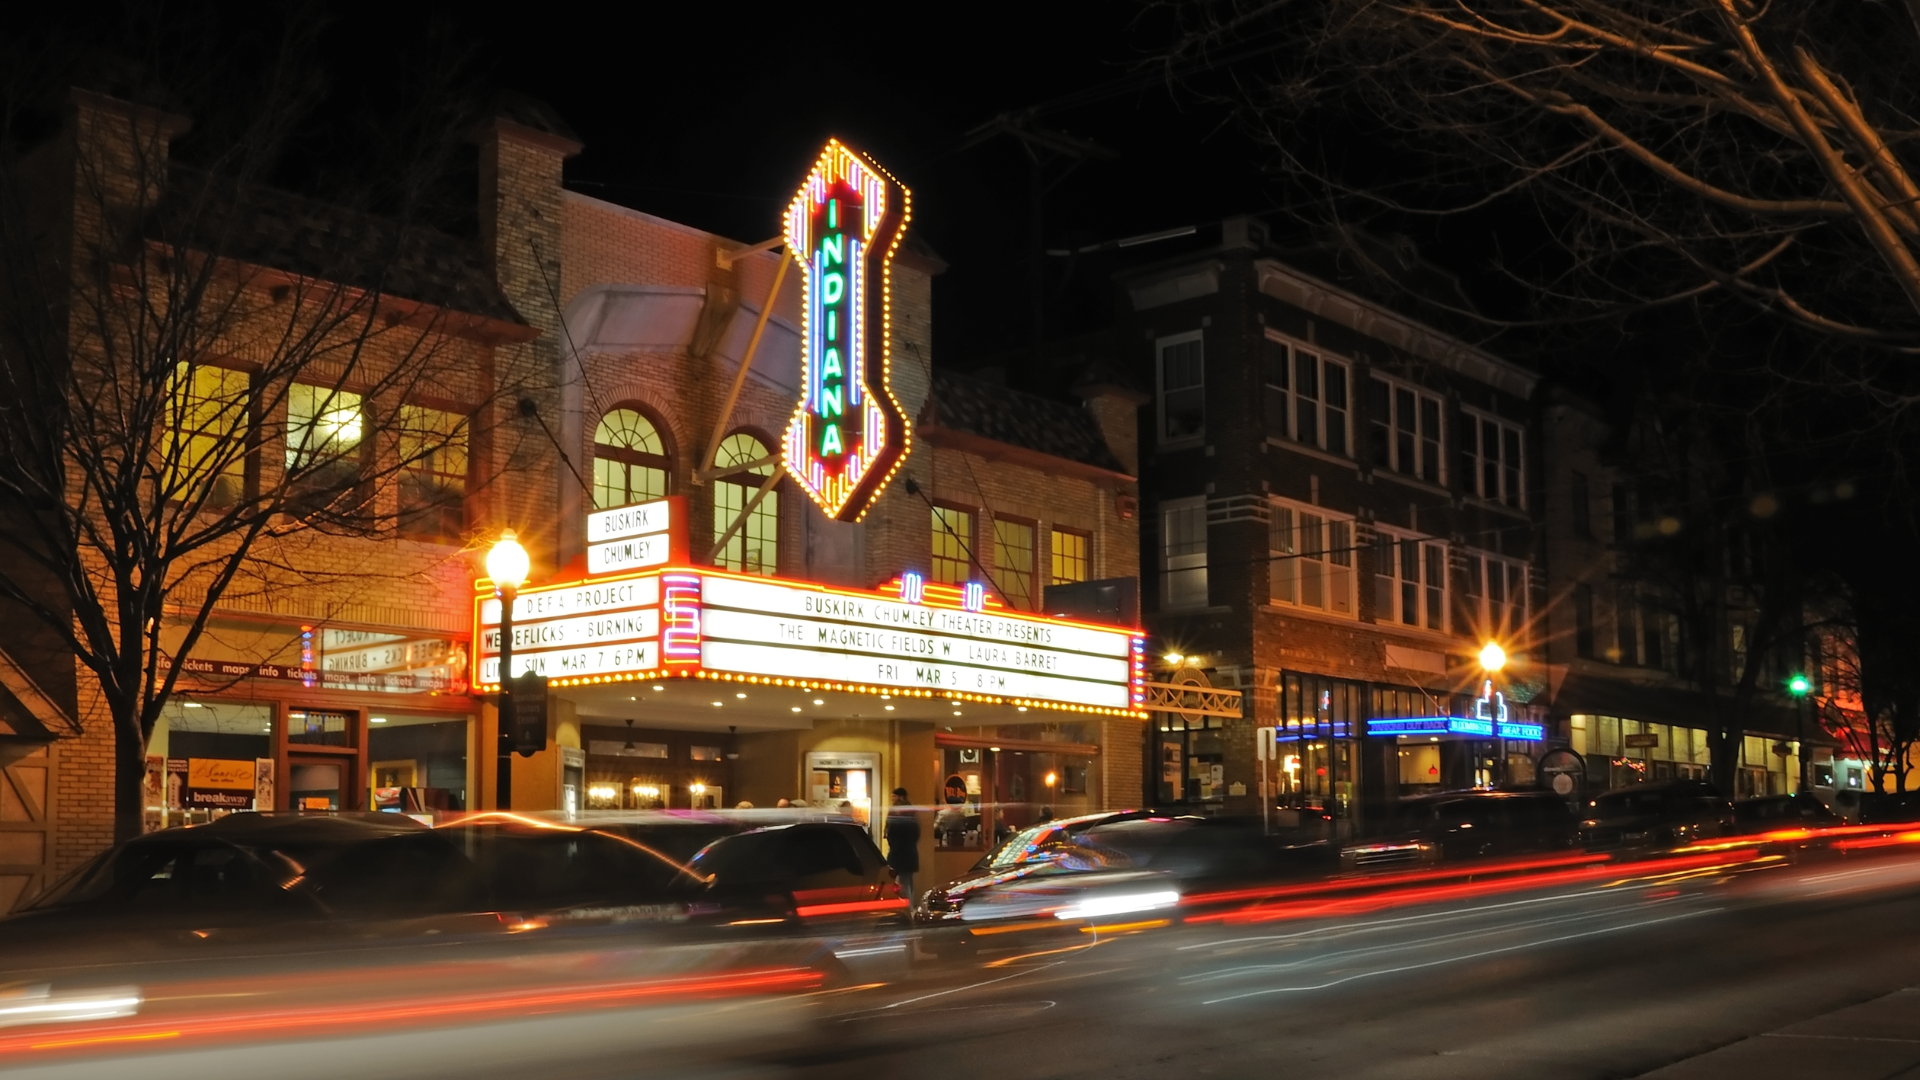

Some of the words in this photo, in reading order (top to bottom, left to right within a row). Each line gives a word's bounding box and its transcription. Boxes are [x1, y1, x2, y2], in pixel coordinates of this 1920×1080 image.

[821, 198, 843, 456] INDIANA
[605, 509, 649, 533] BUSKIRK
[604, 541, 651, 564] CHUMLEY
[576, 585, 634, 607] PROJECT
[588, 616, 643, 637] BURNING
[805, 596, 864, 618] BUSKIRK
[875, 605, 934, 627] CHUMLEY
[942, 614, 992, 634] THEATER
[998, 622, 1052, 643] PRESENTS
[779, 623, 803, 641] THE
[818, 627, 884, 649] MAGNETIC
[892, 636, 935, 655] FIELDS
[943, 641, 952, 656] W
[969, 645, 1007, 663] LAURA
[1016, 651, 1057, 670] BARRET
[525, 657, 546, 673] SUN
[561, 653, 587, 670] MAR
[598, 651, 604, 668] 7
[614, 650, 621, 666] 6
[626, 648, 645, 665] PM
[222, 665, 250, 675] maps
[259, 666, 279, 677] info
[287, 668, 317, 680] tickets
[324, 673, 350, 684] maps
[358, 673, 376, 684] info
[384, 676, 412, 687] tickets
[419, 678, 444, 689] maps
[451, 680, 468, 691] info
[878, 664, 898, 680] FRI
[916, 667, 941, 684] MAR
[952, 671, 957, 685] 5
[977, 674, 983, 688] 8
[990, 675, 1006, 690] PM
[1406, 722, 1422, 730] OUT
[1423, 721, 1446, 729] BACK
[1522, 727, 1541, 737] FOOD
[193, 792, 248, 805] breakaway
